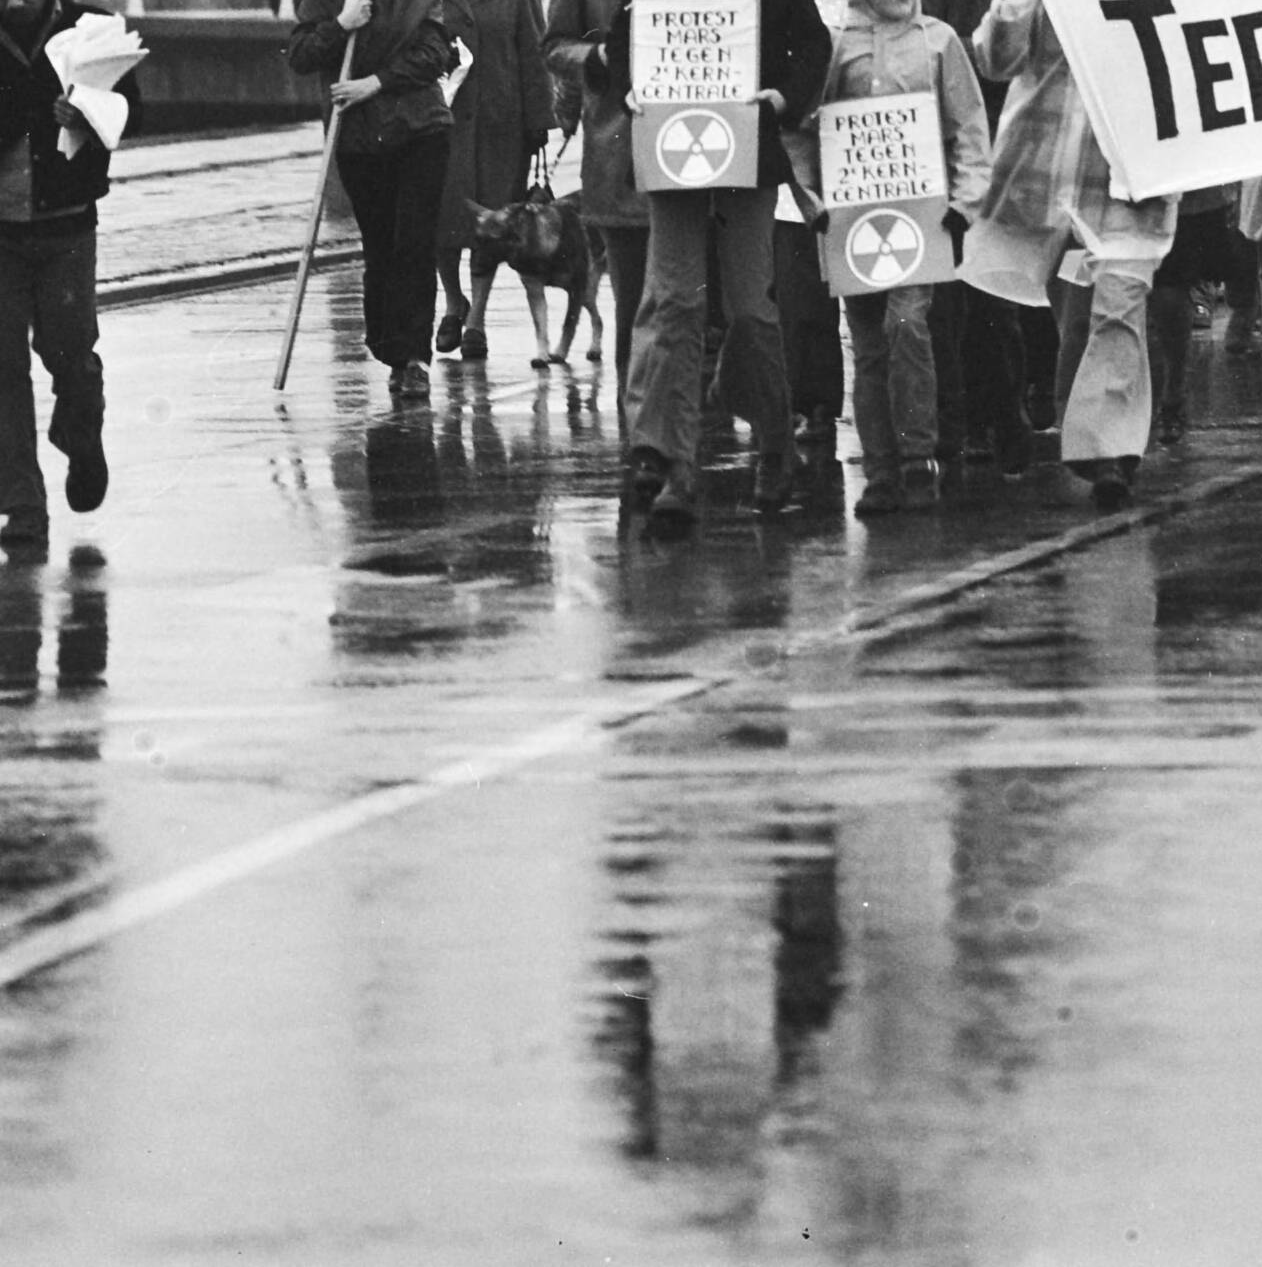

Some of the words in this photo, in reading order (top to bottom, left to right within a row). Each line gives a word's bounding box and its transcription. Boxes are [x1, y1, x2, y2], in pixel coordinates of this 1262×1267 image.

[652, 11, 738, 27] PROTEST
[666, 28, 721, 44] MARS
[659, 46, 731, 63] TEGEN
[675, 65, 741, 82] KERN-
[642, 84, 742, 100] CENTRALE
[835, 107, 918, 131] PROTEST
[851, 126, 904, 146] MARS
[844, 142, 916, 164] TEGEN
[832, 179, 933, 202] CENTRALE
